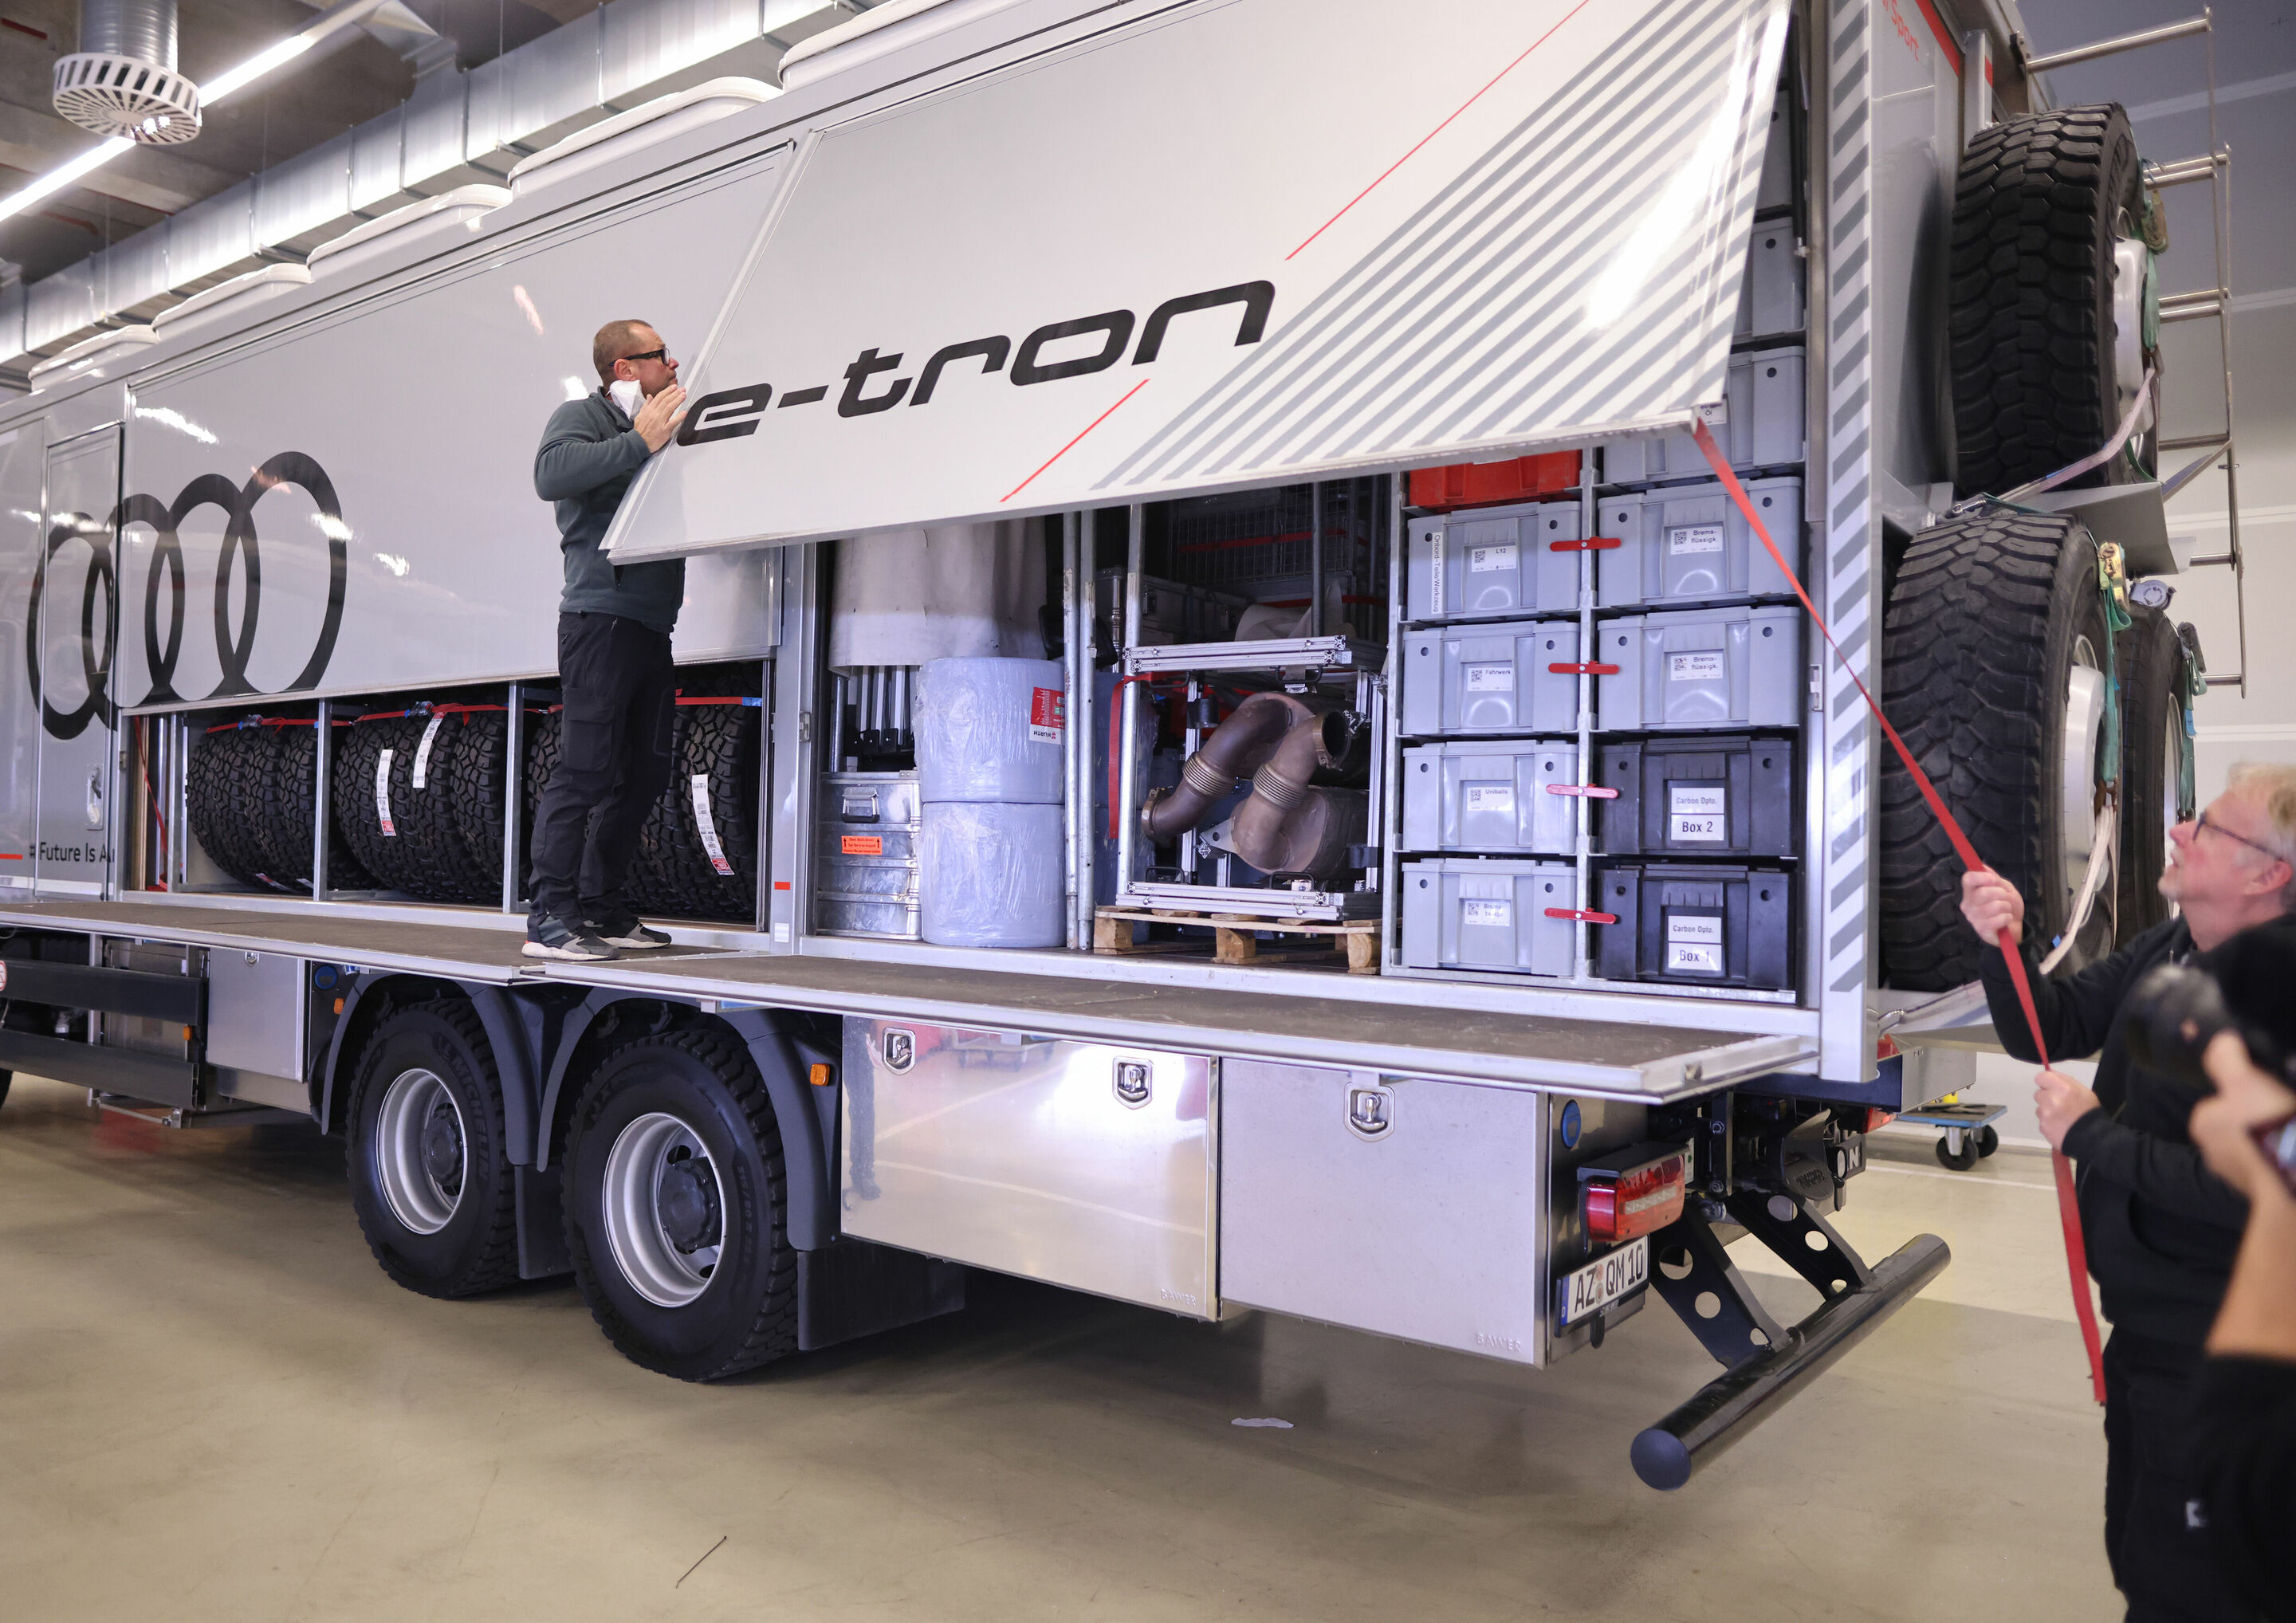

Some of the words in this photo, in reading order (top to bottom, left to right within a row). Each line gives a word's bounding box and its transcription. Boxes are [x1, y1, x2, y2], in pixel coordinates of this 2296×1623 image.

[676, 280, 1276, 446] e-tron
[1682, 821, 1702, 833] Box
[1707, 821, 1713, 832] 2
[85, 843, 96, 863] Is
[1679, 949, 1700, 962] Box
[1706, 950, 1710, 962] 1
[1575, 1267, 1596, 1314] AZ
[1606, 1253, 1625, 1296] QM
[1628, 1244, 1643, 1286] 10
